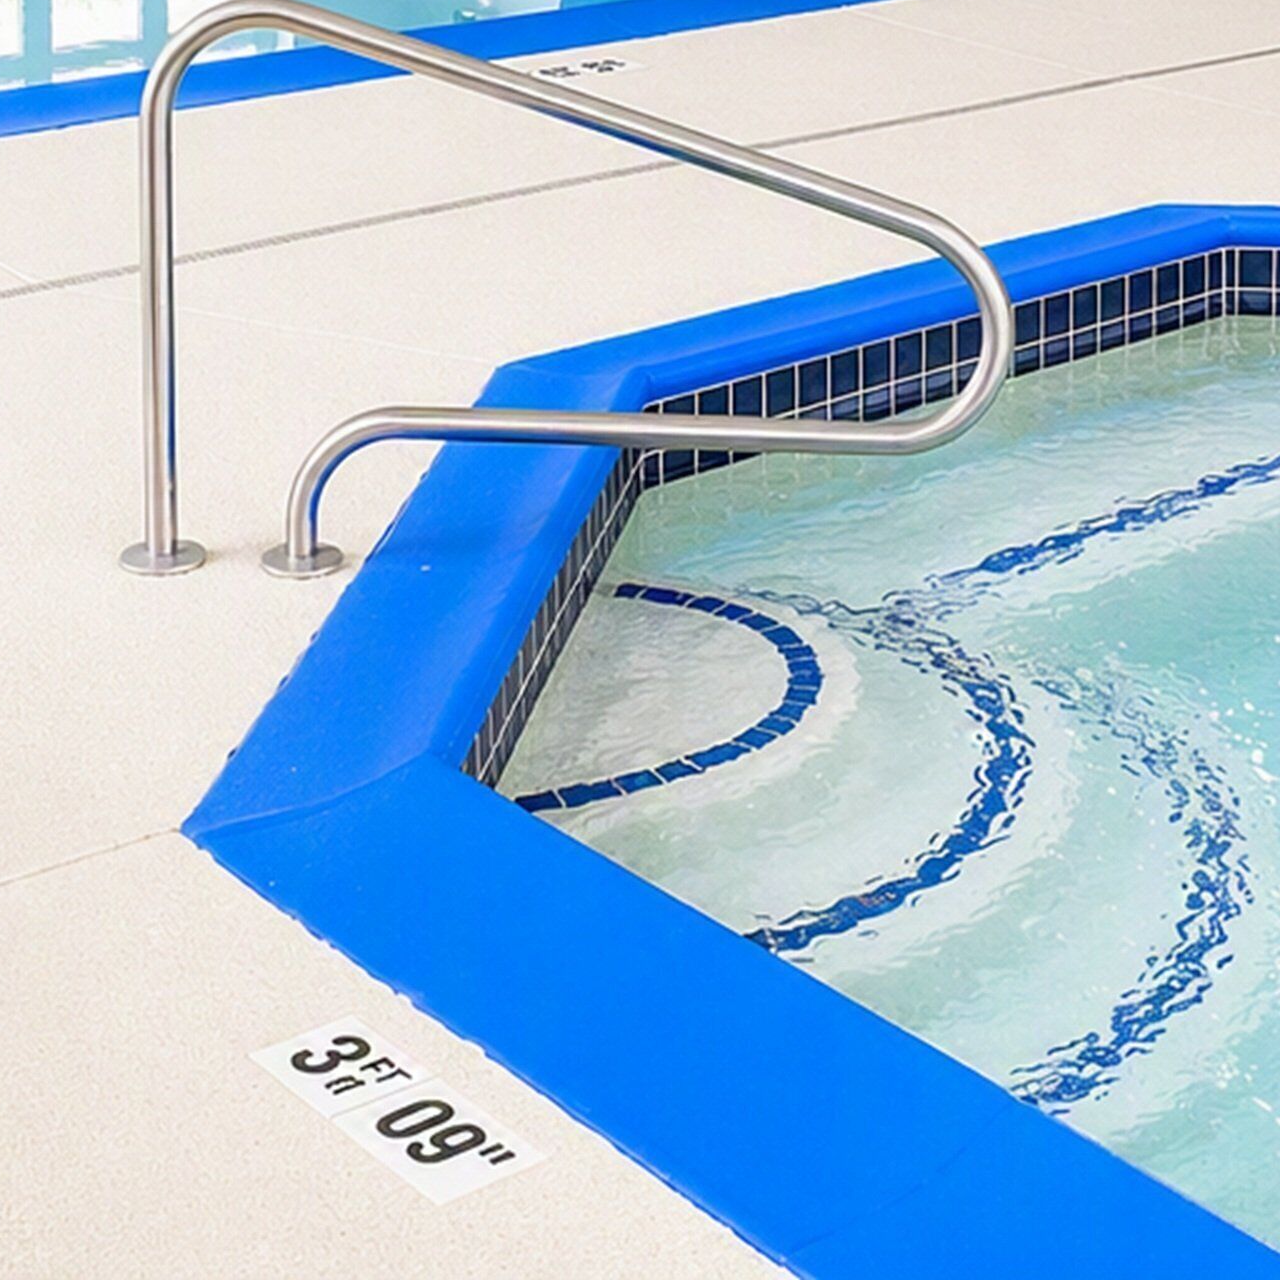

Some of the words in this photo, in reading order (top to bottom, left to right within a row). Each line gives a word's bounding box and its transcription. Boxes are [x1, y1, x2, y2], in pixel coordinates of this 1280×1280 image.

[290, 1035, 371, 1074] 3
[360, 1057, 413, 1083] FT
[376, 1099, 517, 1165] 09"
